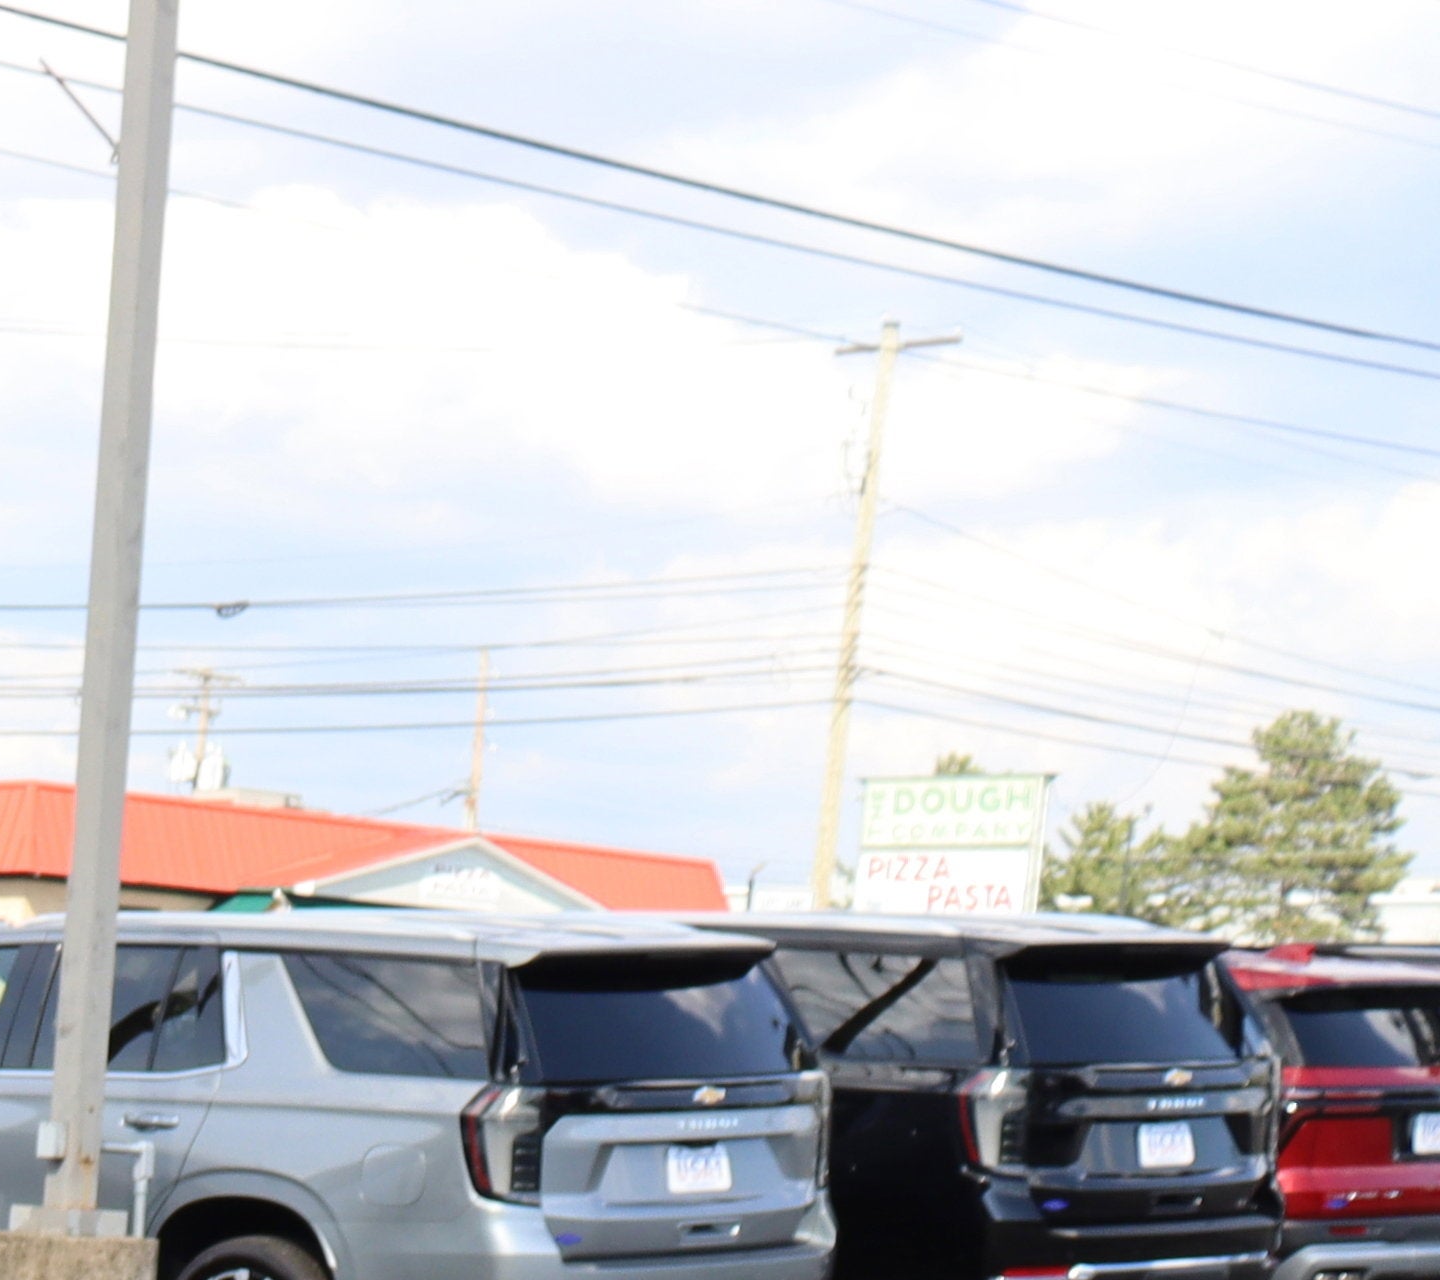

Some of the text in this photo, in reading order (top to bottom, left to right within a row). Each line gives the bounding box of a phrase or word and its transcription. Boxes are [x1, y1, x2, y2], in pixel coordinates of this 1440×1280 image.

[894, 786, 1032, 815] DOUGH
[892, 822, 1031, 840] COMPANY
[868, 856, 950, 882] PIZZA
[927, 883, 1012, 912] PASTA
